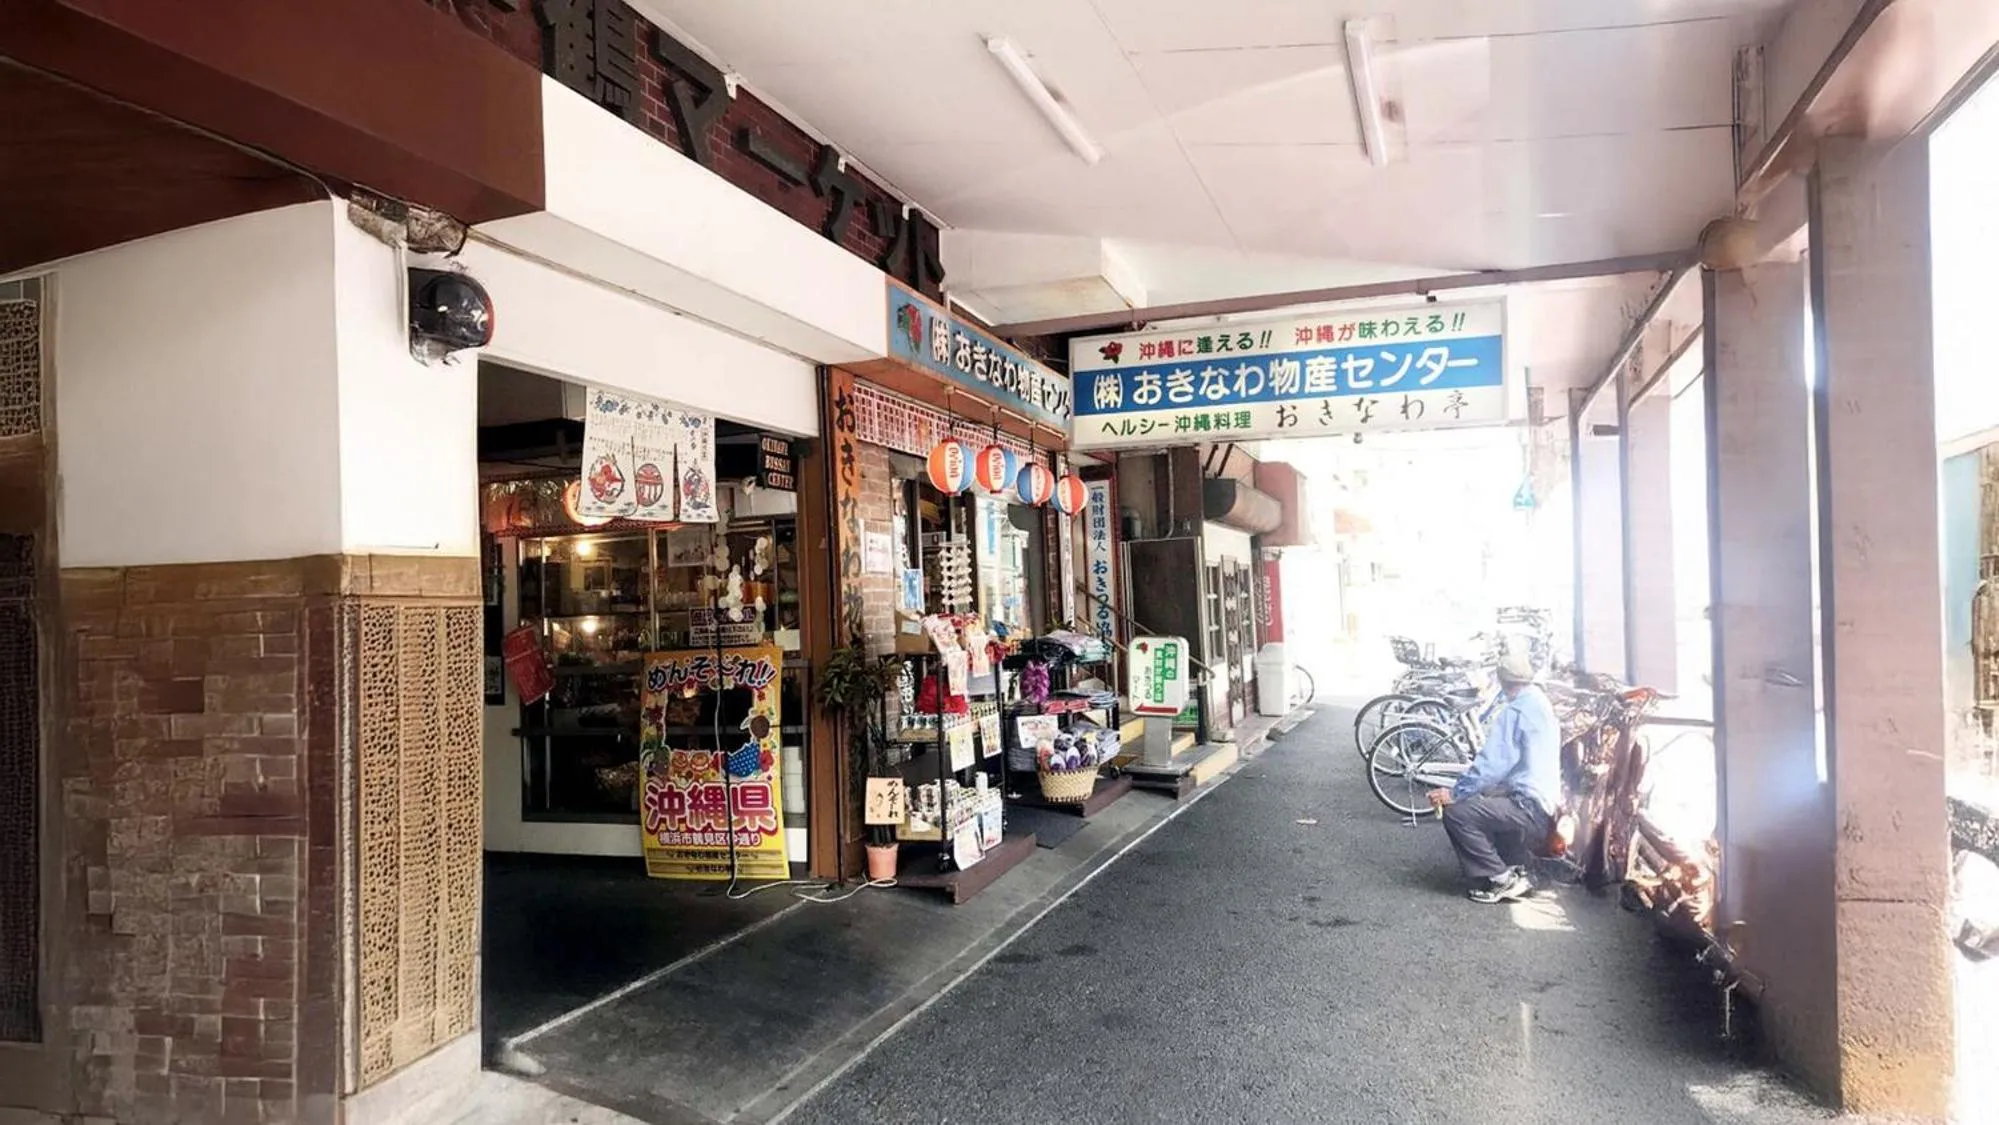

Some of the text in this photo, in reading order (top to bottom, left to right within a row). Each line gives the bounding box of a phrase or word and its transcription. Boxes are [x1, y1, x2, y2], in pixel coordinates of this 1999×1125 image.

[1295, 312, 1466, 345] 沖縄が味わえる!!
[1101, 389, 1469, 437] ヘルシー沖縄料理 おきなわ亭
[1091, 485, 1106, 552] 一般財団法人
[645, 782, 776, 832] 沖縄県
